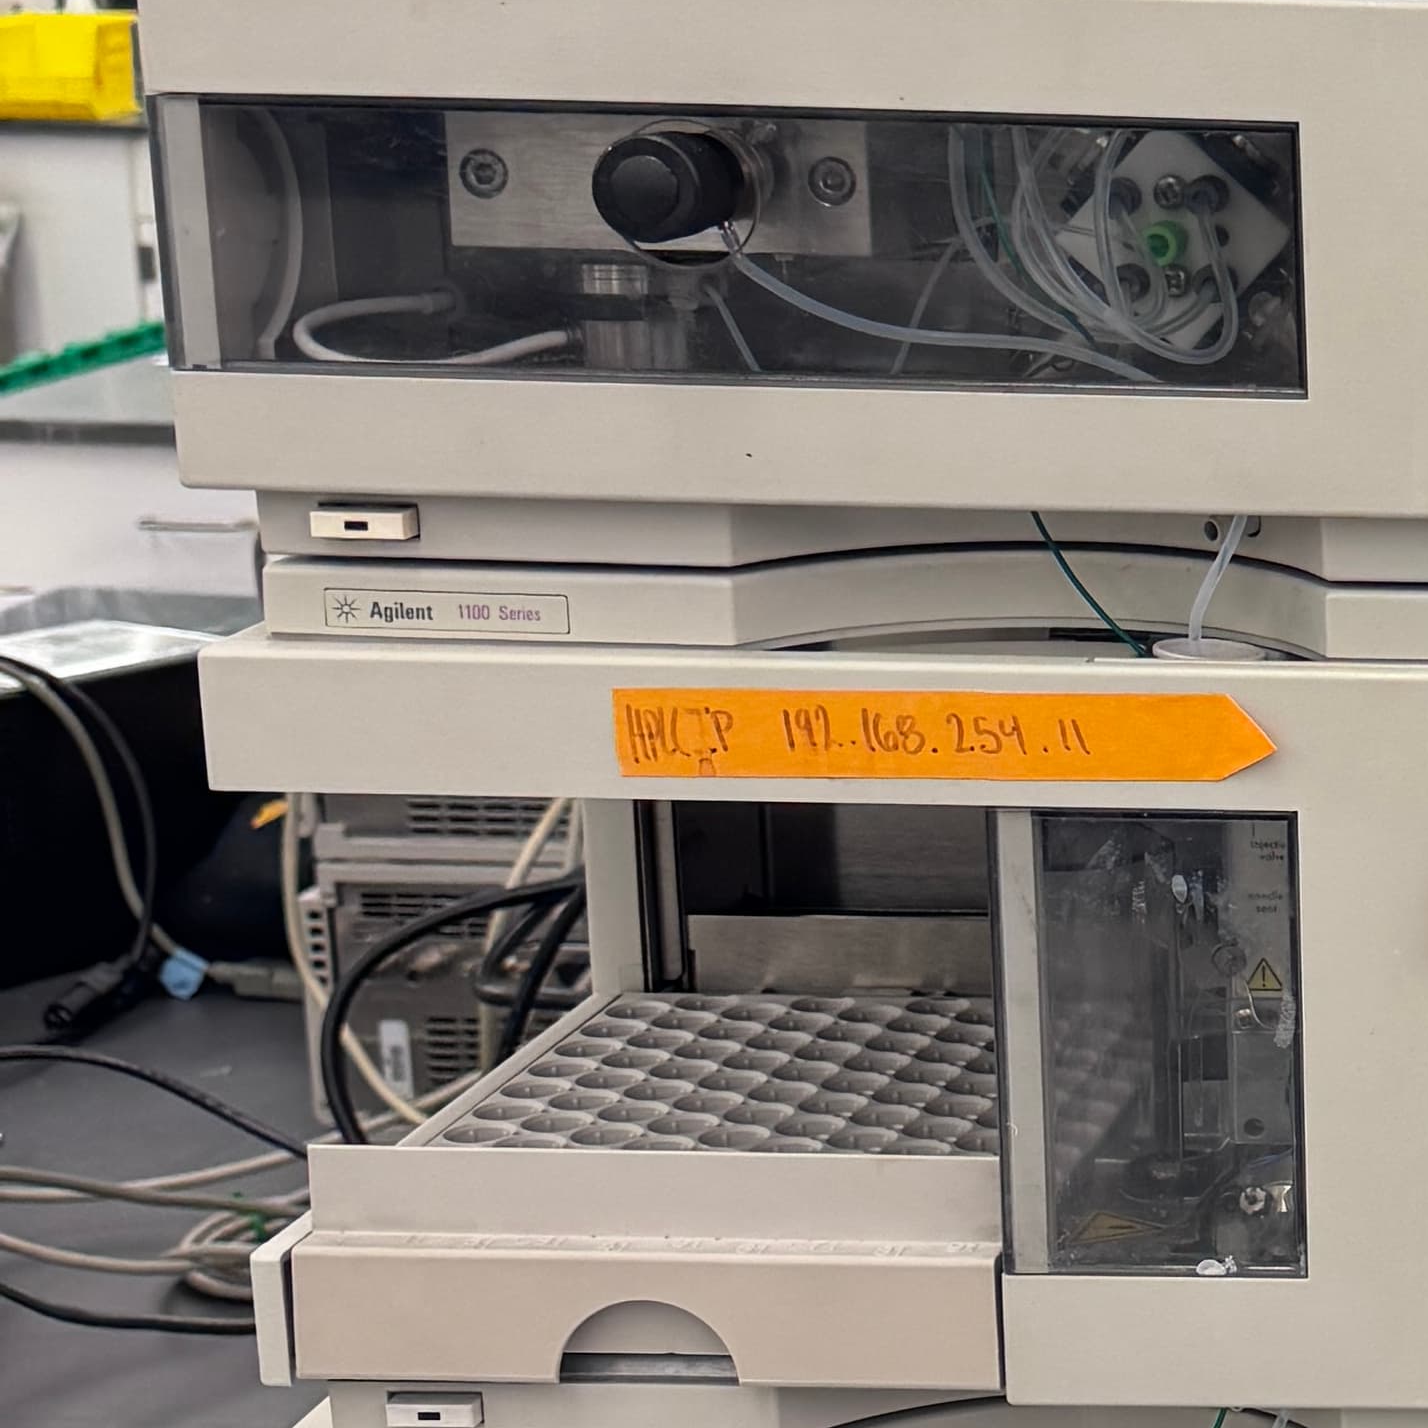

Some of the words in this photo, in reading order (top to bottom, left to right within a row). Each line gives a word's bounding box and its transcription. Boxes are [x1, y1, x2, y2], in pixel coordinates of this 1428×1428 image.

[369, 601, 433, 623] Agilent
[458, 603, 490, 620] 1100
[498, 605, 541, 622] Series
